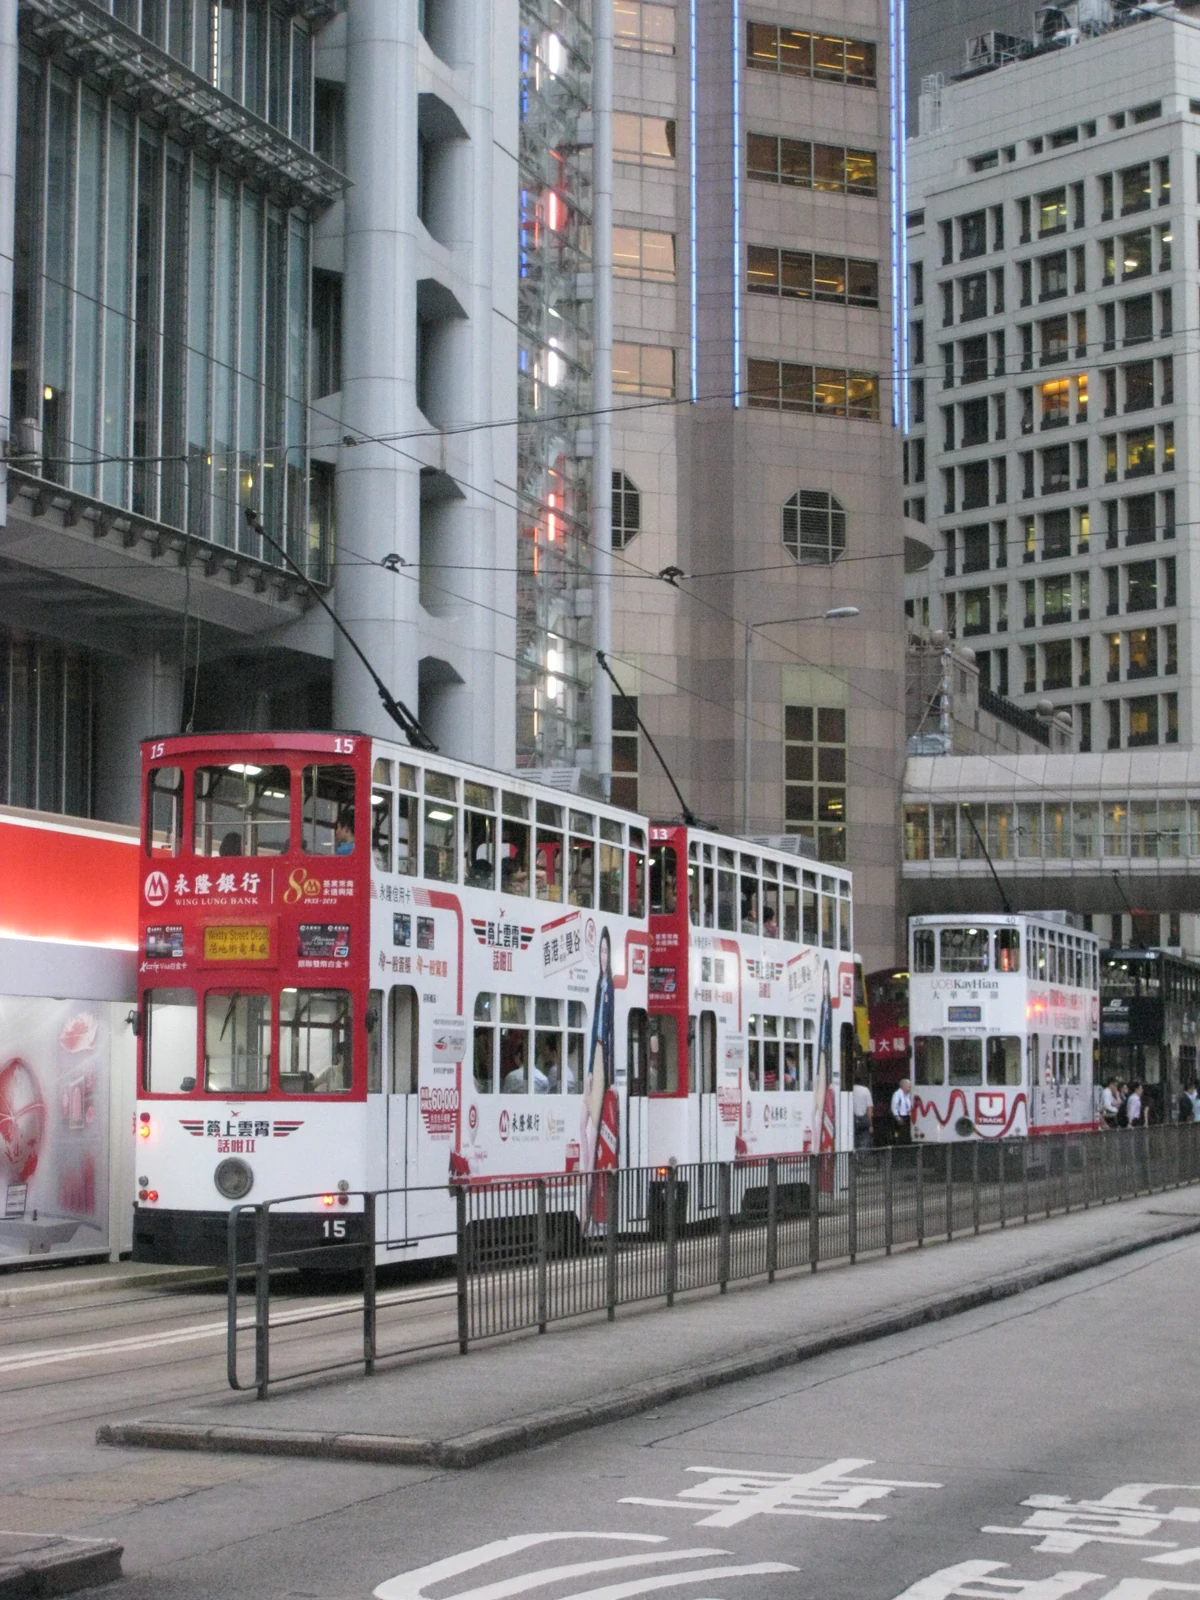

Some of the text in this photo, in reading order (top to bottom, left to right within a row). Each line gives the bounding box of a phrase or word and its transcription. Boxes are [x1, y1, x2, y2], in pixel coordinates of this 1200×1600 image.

[150, 743, 165, 760] 15
[334, 738, 355, 754] 15
[652, 829, 668, 840] 13
[173, 873, 261, 896] 永隆銀行
[175, 897, 259, 906] WING LUNG BANK
[229, 928, 249, 941] Street
[206, 1120, 270, 1137] 簽上雲霄
[322, 1220, 346, 1238] 15
[617, 1458, 944, 1528] 車
